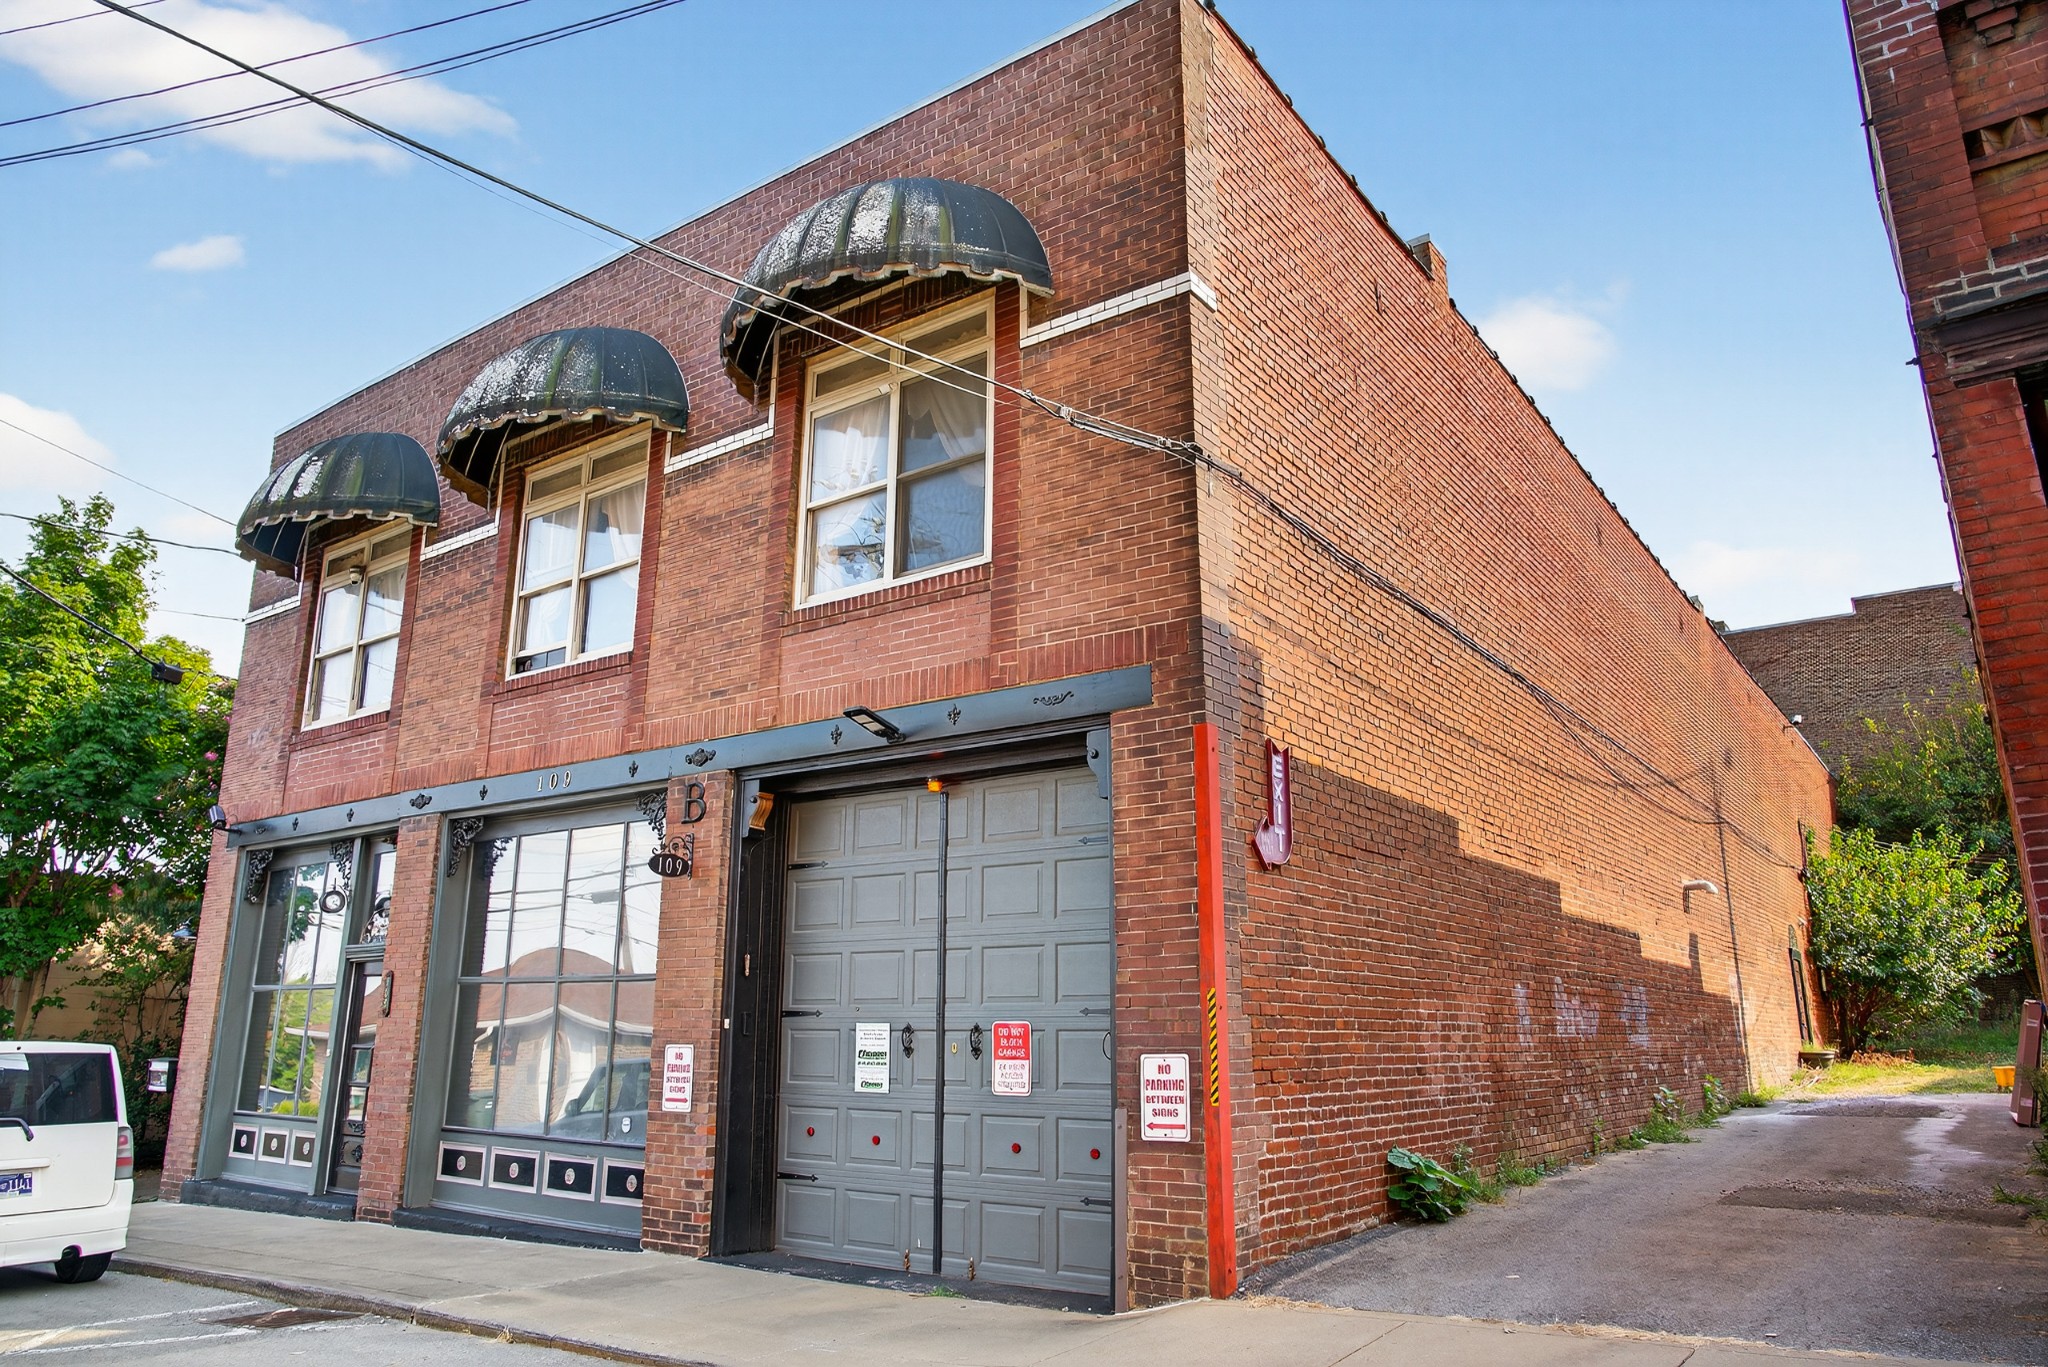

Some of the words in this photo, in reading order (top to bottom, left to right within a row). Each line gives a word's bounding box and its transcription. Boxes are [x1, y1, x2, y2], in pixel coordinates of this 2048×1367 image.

[537, 770, 572, 792] 109
[681, 782, 707, 825] B
[1272, 753, 1286, 854] EXIT
[658, 857, 683, 876] 109
[1157, 1063, 1171, 1075] NO
[1145, 1079, 1185, 1091] PARKING
[1145, 1095, 1185, 1105] BETWEEN
[1151, 1108, 1179, 1118] SIGNS
